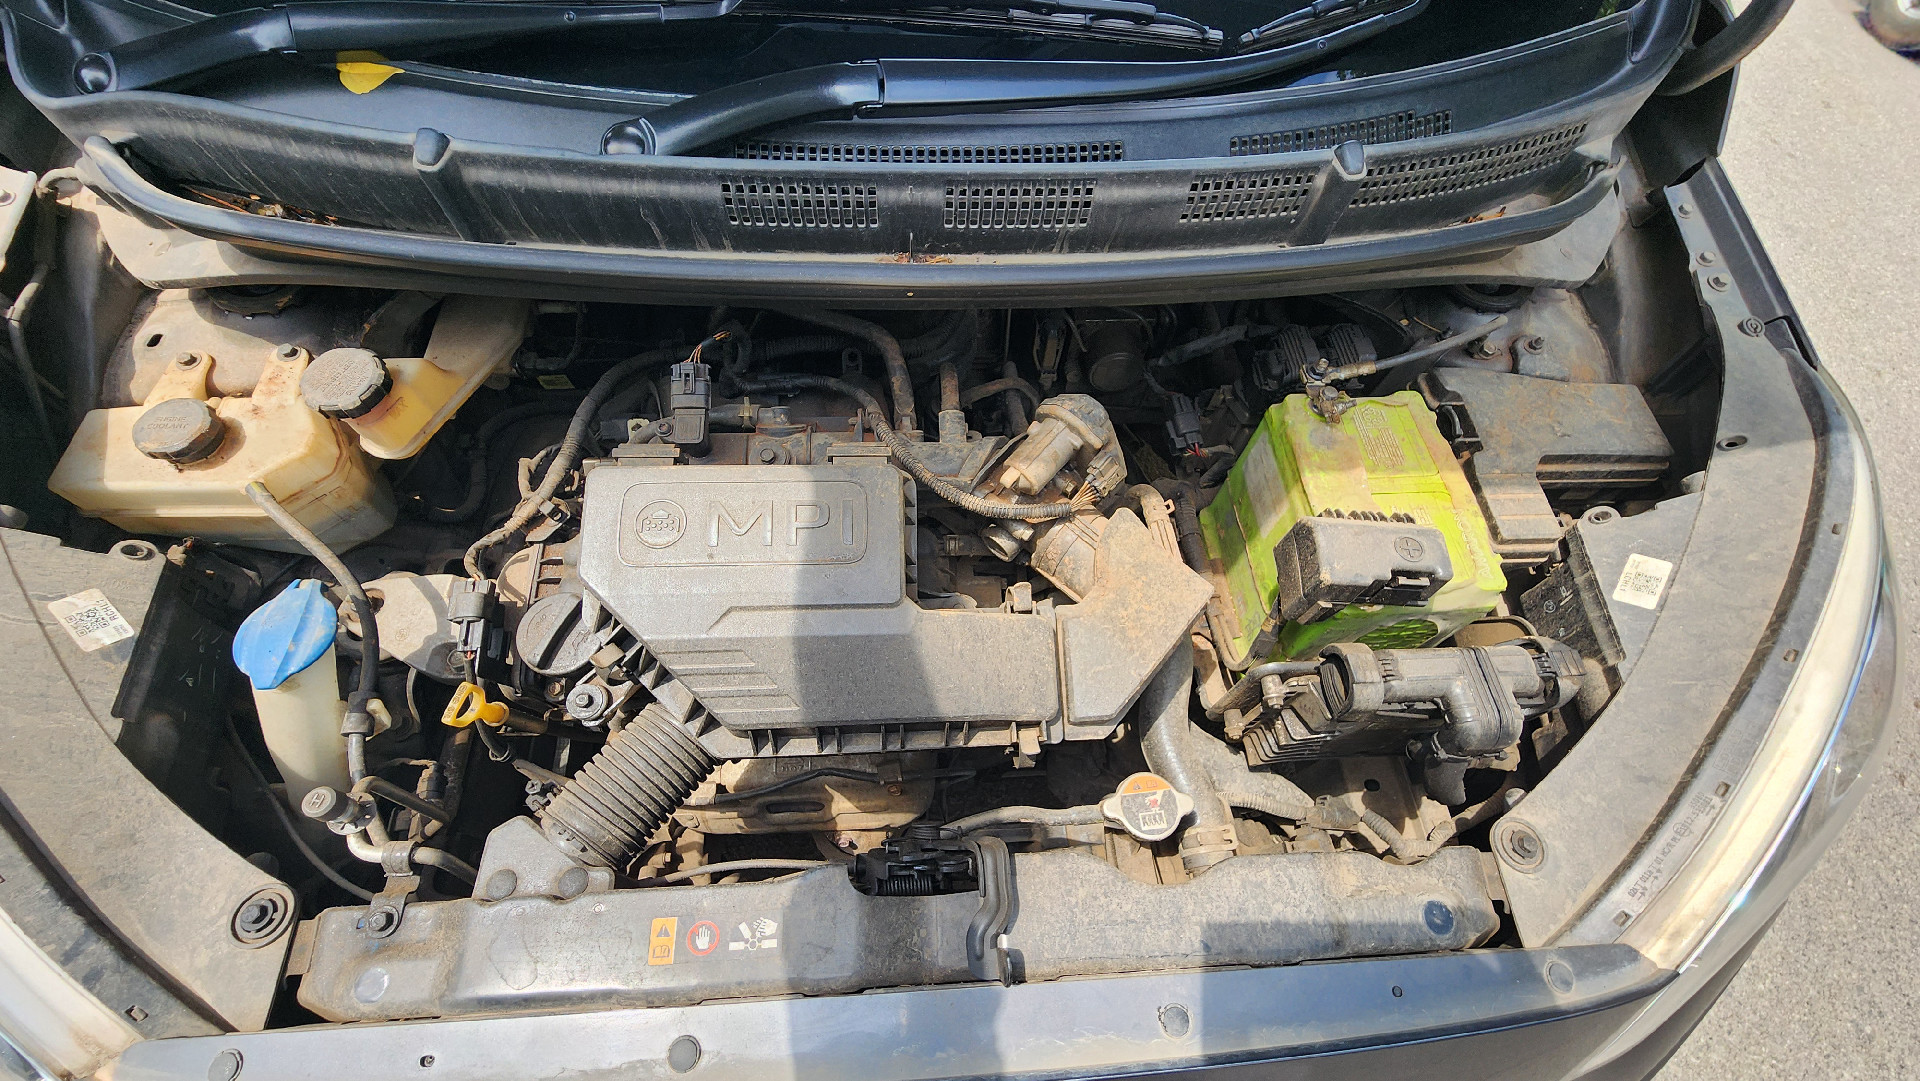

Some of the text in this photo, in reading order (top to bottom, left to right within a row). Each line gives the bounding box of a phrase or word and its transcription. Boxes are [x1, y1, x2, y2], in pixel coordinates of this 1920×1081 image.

[146, 422, 190, 430] COOLANT
[707, 499, 854, 547] MPI
[309, 792, 326, 809] H
